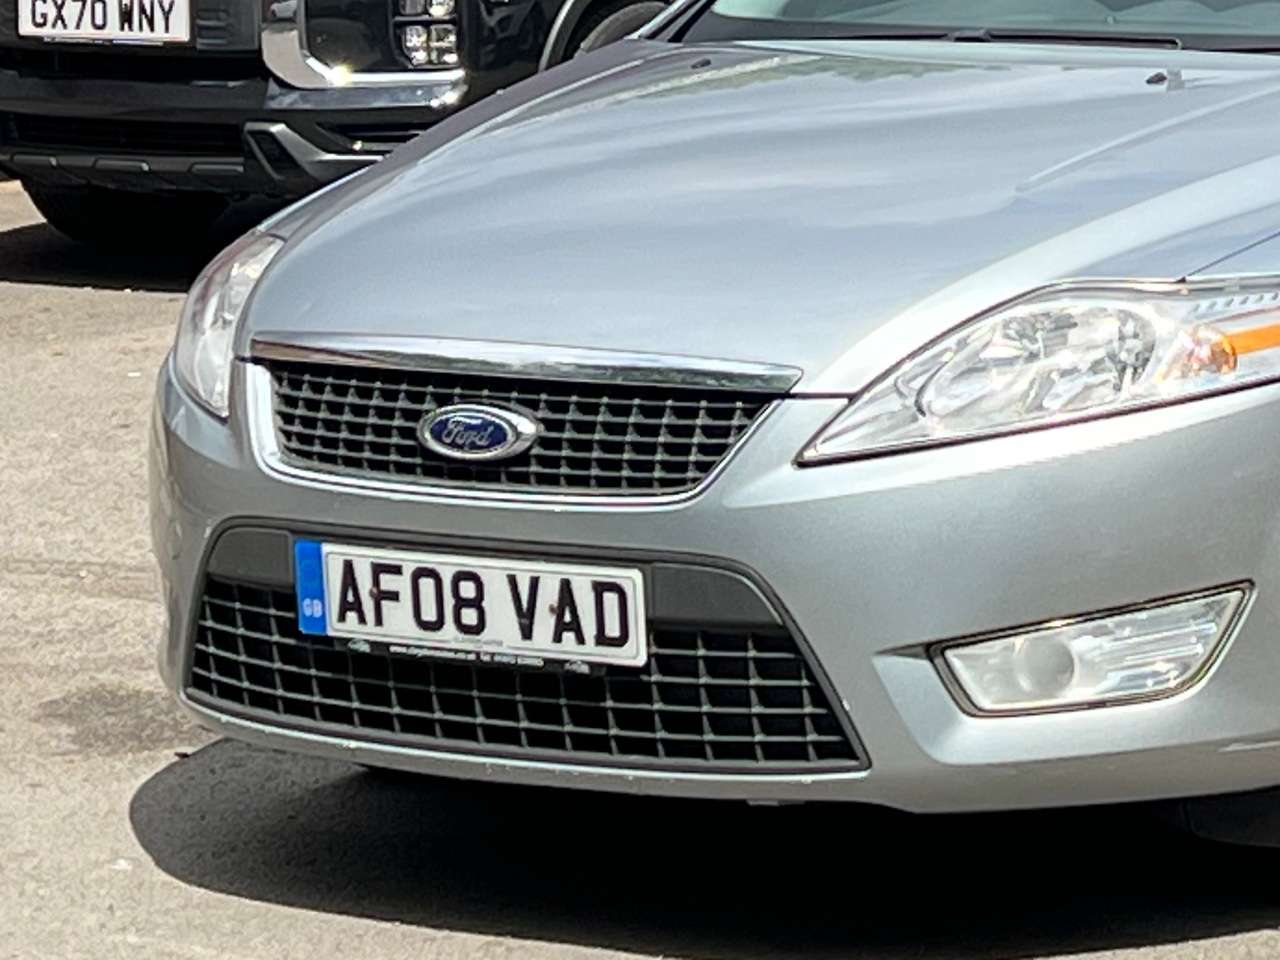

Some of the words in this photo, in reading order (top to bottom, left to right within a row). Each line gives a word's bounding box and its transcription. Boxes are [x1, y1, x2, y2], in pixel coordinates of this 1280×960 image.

[441, 415, 495, 450] Ford
[302, 597, 323, 618] GB
[336, 557, 487, 637] AF08
[506, 572, 630, 649] VAD
